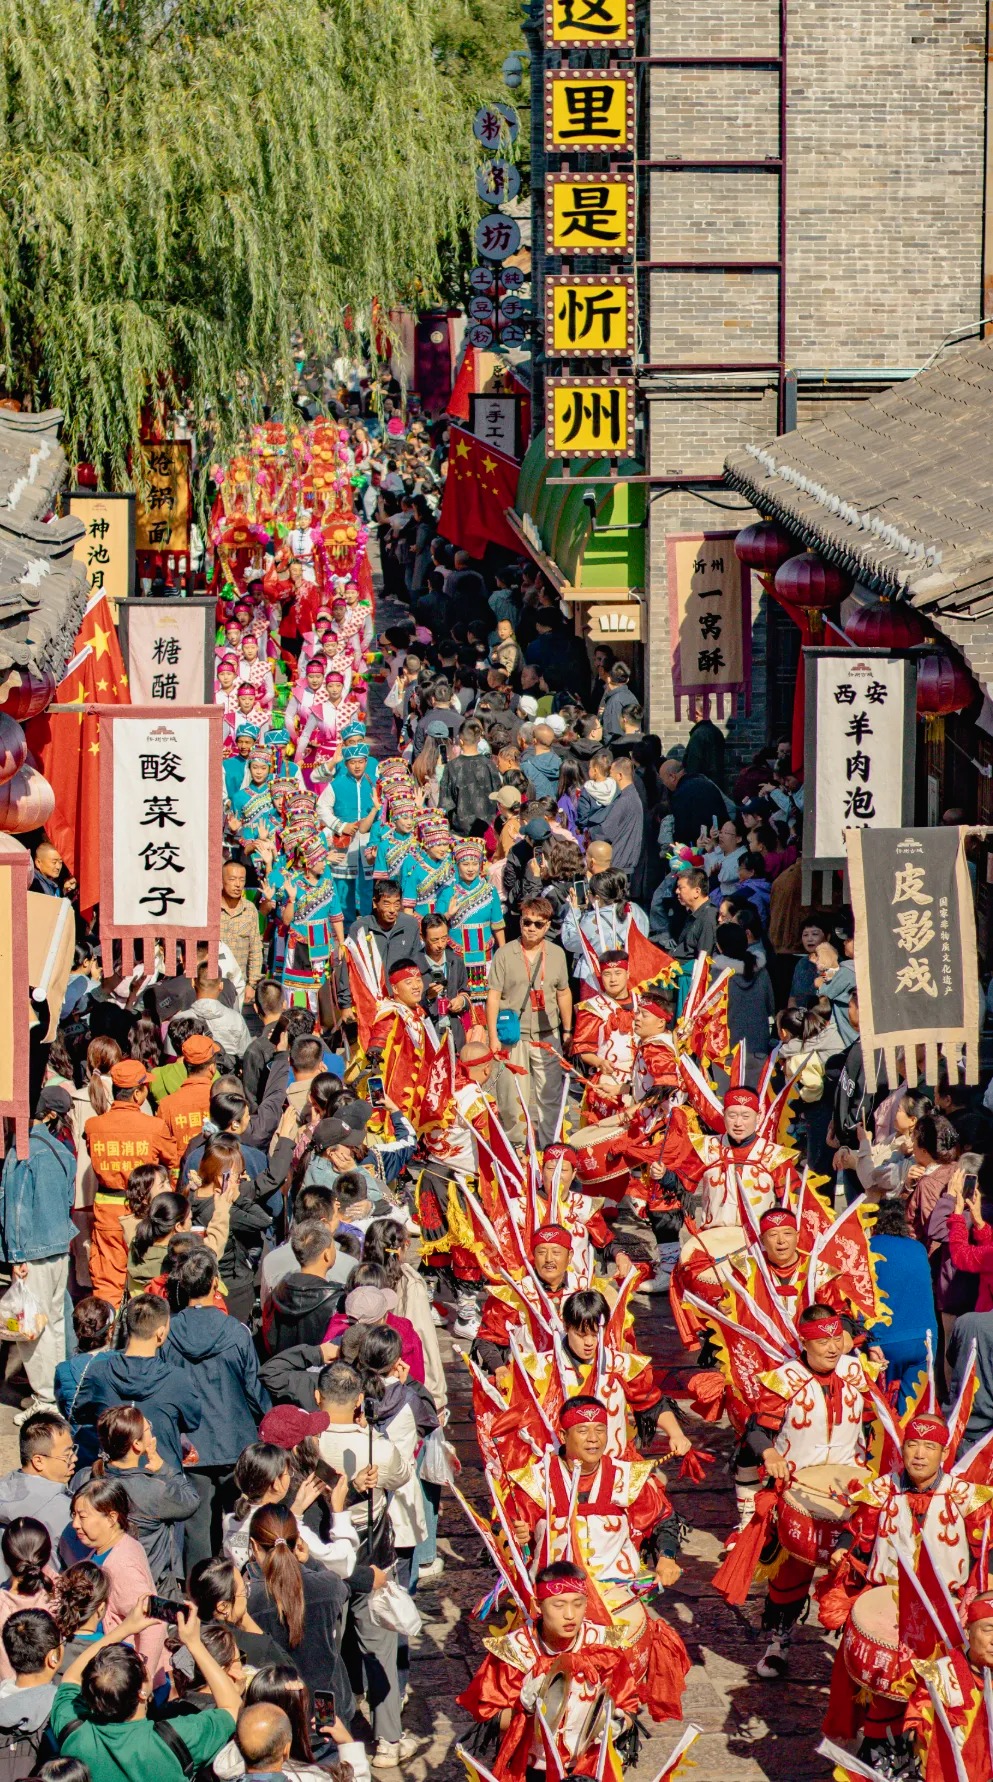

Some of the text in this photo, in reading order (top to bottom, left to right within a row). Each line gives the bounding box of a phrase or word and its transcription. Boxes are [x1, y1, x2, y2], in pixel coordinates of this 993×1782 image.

[558, 0, 622, 446] 这里是忻州
[473, 272, 492, 343] 土豆粉
[485, 410, 505, 447] 手工
[87, 518, 112, 596] 神池月
[692, 558, 725, 574] 忻州
[151, 636, 182, 700] 糖醋
[698, 588, 726, 675] 一窝酥
[833, 681, 888, 705] 西安
[842, 711, 876, 845] 羊肉泡
[138, 751, 186, 917] 酸菜饺子
[891, 862, 938, 998] 皮影戏
[939, 897, 953, 996] 国家非物质文化遗产
[93, 1140, 149, 1157] 中国消防
